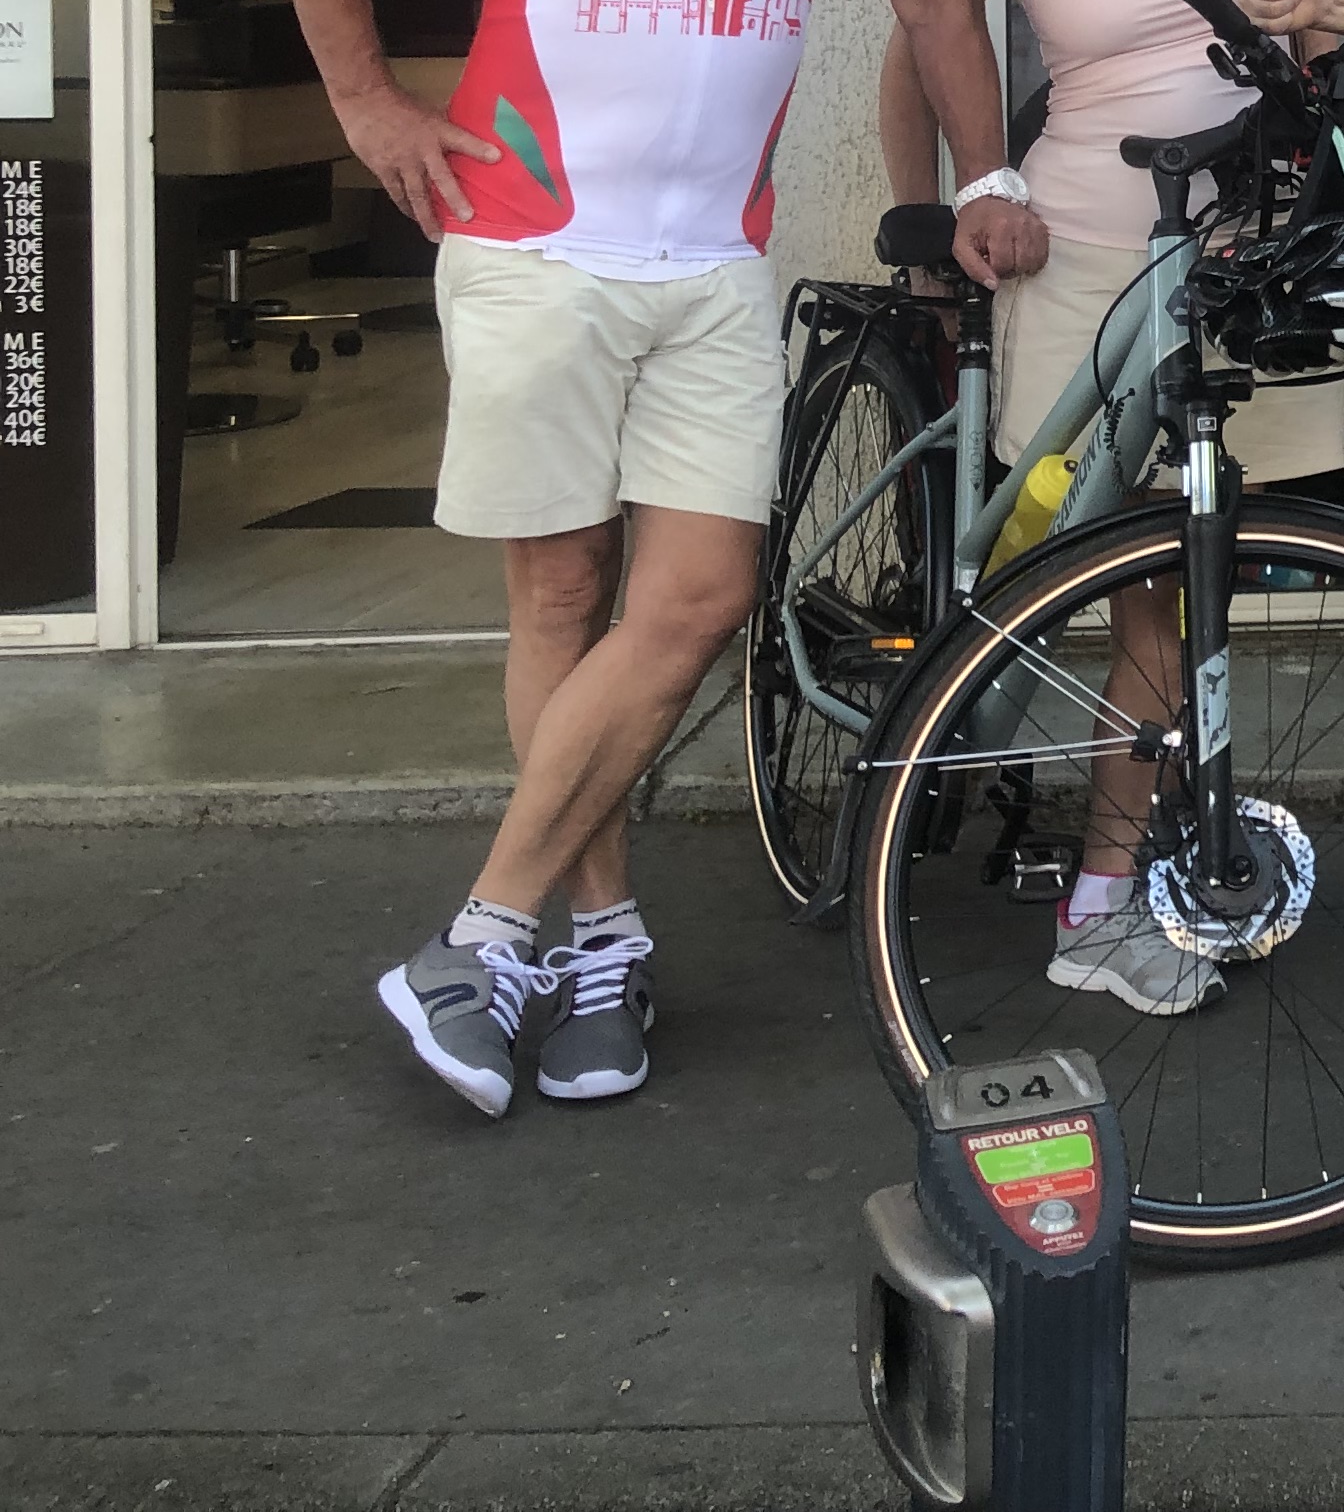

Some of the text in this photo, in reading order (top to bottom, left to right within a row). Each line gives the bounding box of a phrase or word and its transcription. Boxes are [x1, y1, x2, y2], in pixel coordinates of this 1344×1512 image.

[2, 180, 43, 198] 24€
[4, 199, 44, 217] 18€
[4, 218, 44, 236] 18€
[3, 237, 44, 256] 30€
[5, 256, 44, 274] 18€
[3, 275, 45, 294] 22€
[14, 294, 45, 314] 3€
[5, 351, 46, 370] 36€
[6, 370, 46, 391] 20€
[6, 390, 46, 408] 24€
[4, 408, 47, 429] 40€
[4, 428, 47, 446] 44€
[1047, 417, 1103, 535] GAMONT
[980, 1075, 1055, 1108] 04
[968, 1119, 1089, 1151] RETOUR VELO
